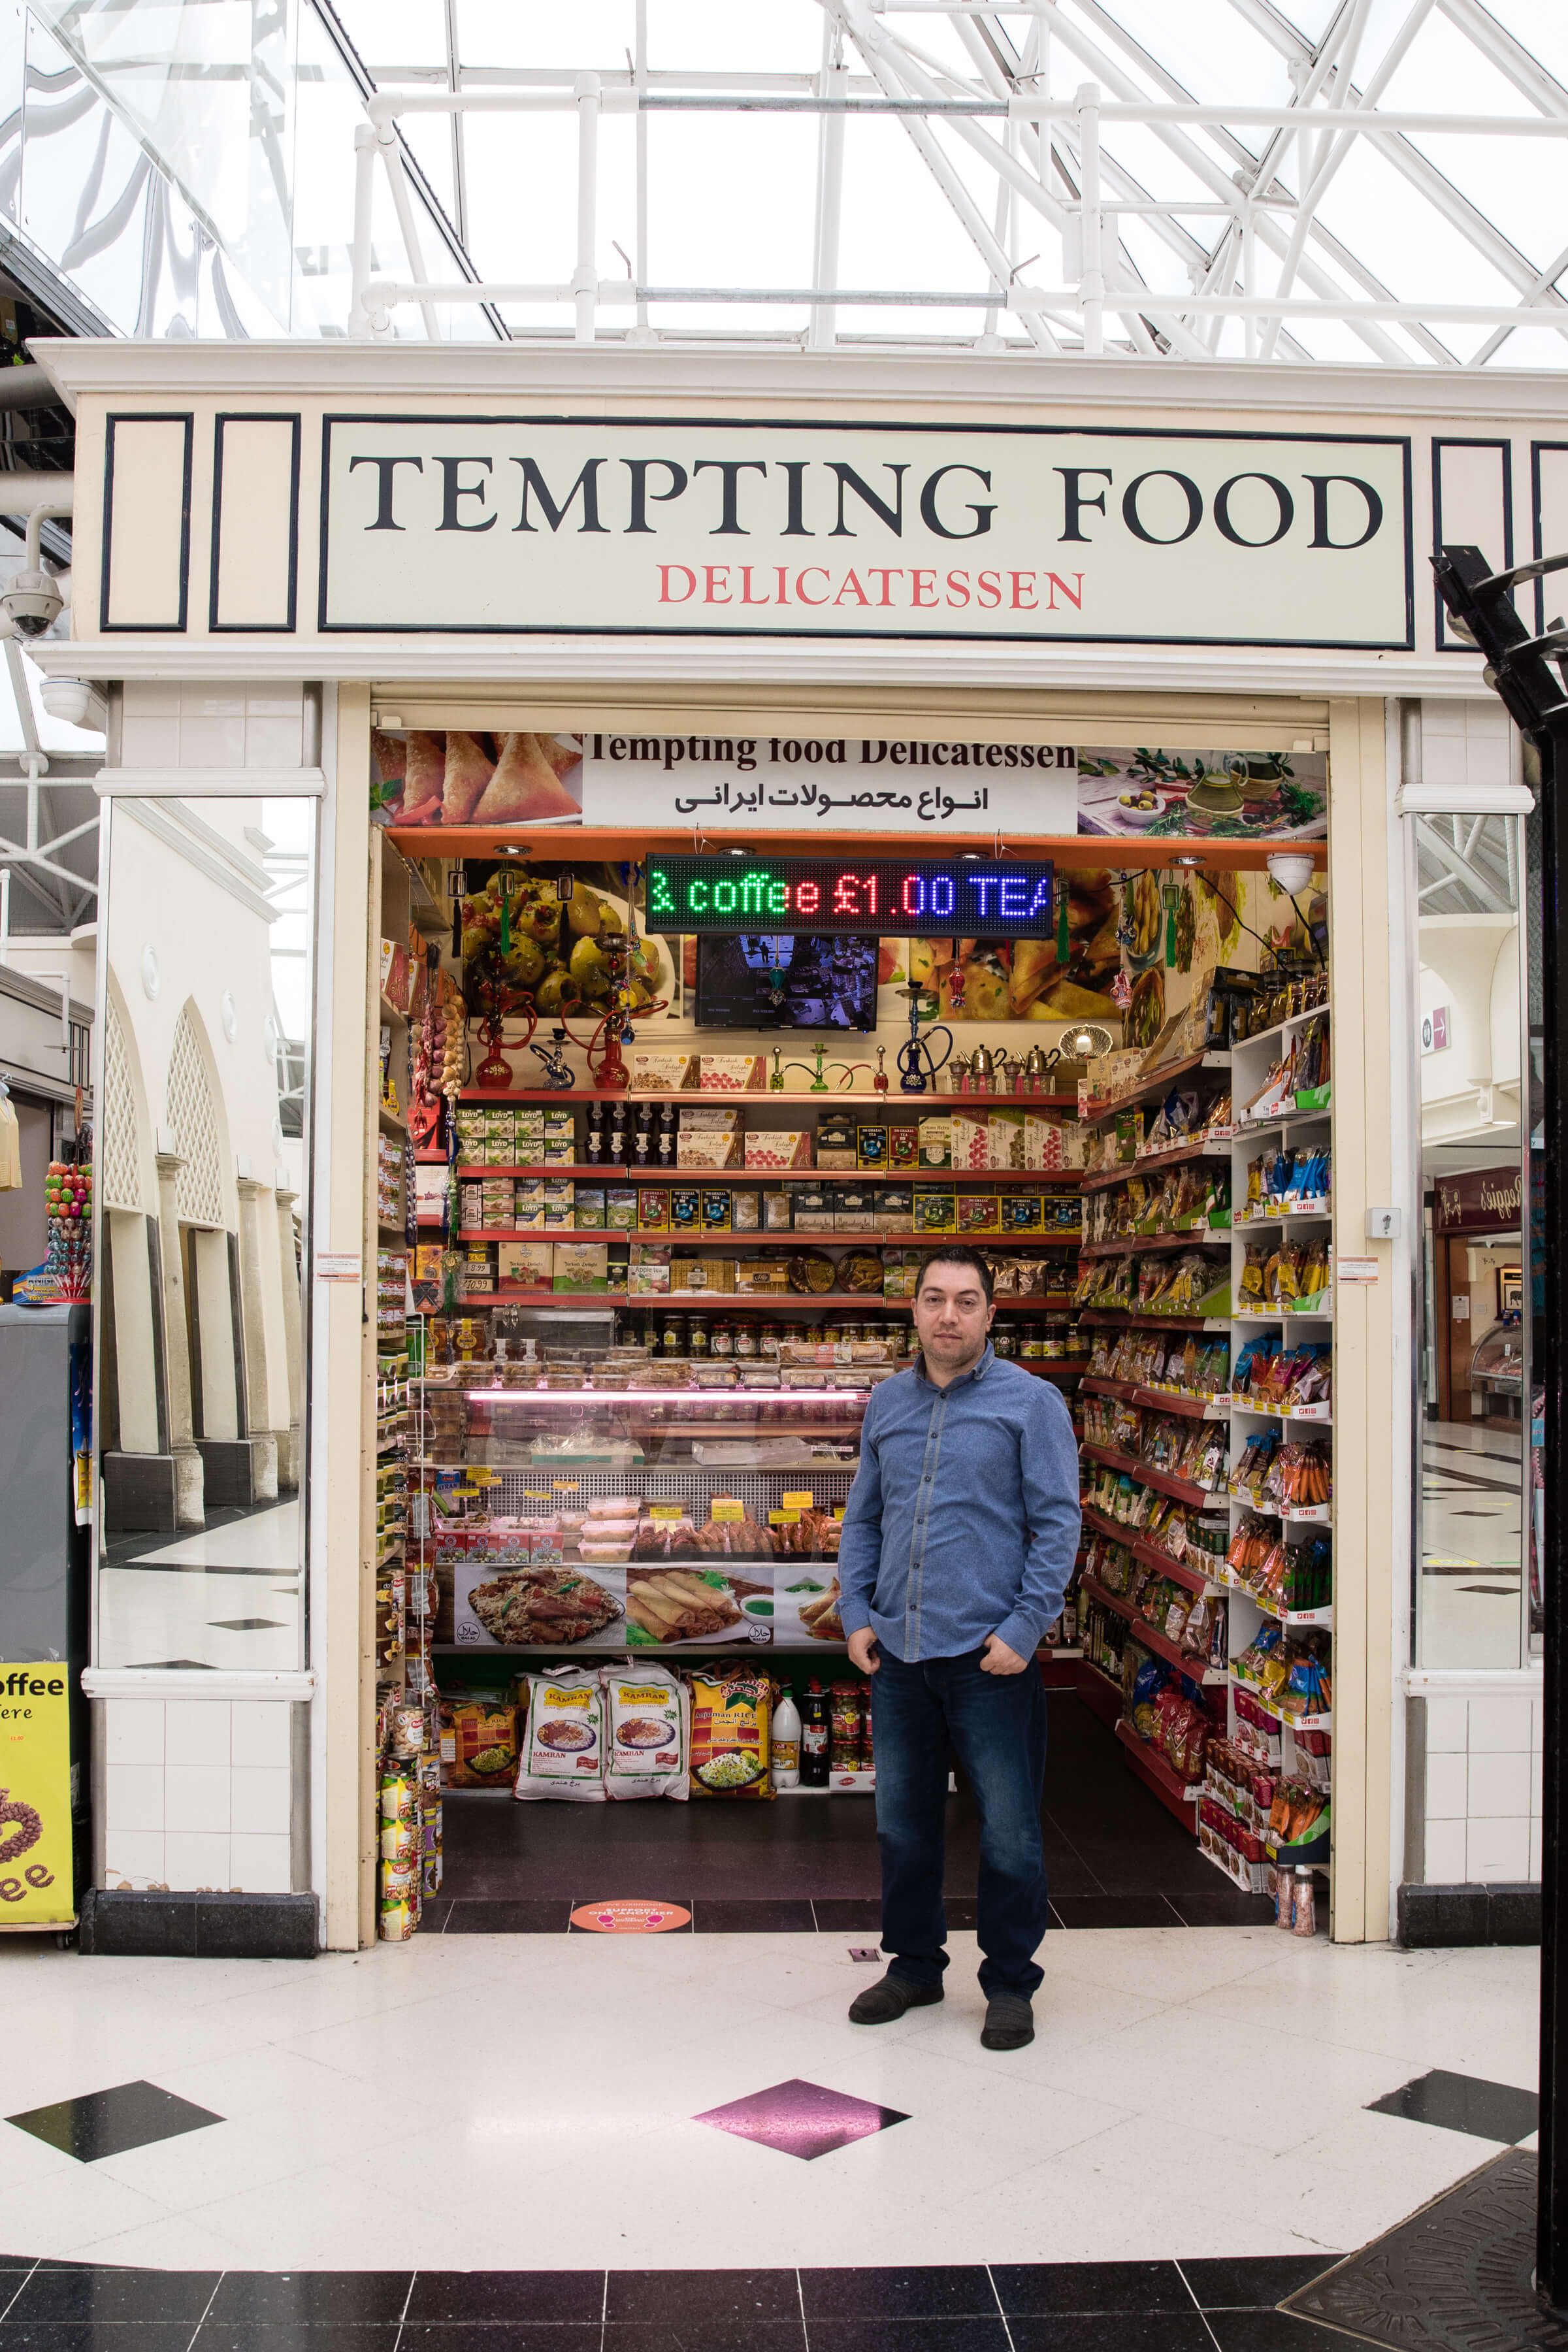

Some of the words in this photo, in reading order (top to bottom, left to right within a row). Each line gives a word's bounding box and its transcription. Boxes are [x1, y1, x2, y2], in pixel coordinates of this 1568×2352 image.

[350, 457, 999, 540] TEMPTING
[1053, 467, 1384, 550] FOOD
[658, 564, 1085, 612] DELICATESSEN
[587, 734, 758, 771] Tempting
[769, 737, 848, 764] food
[858, 739, 1079, 770] Delicatessen
[675, 783, 764, 814] ایرانی
[768, 784, 912, 817] محصولات
[917, 787, 988, 821] انواع
[689, 874, 820, 914] coffee
[834, 875, 955, 915] £1.00
[458, 1625, 478, 1637] حلال
[749, 1627, 770, 1637] حلال
[0, 1672, 64, 1696] ffee
[549, 1692, 590, 1703] KAMRAN
